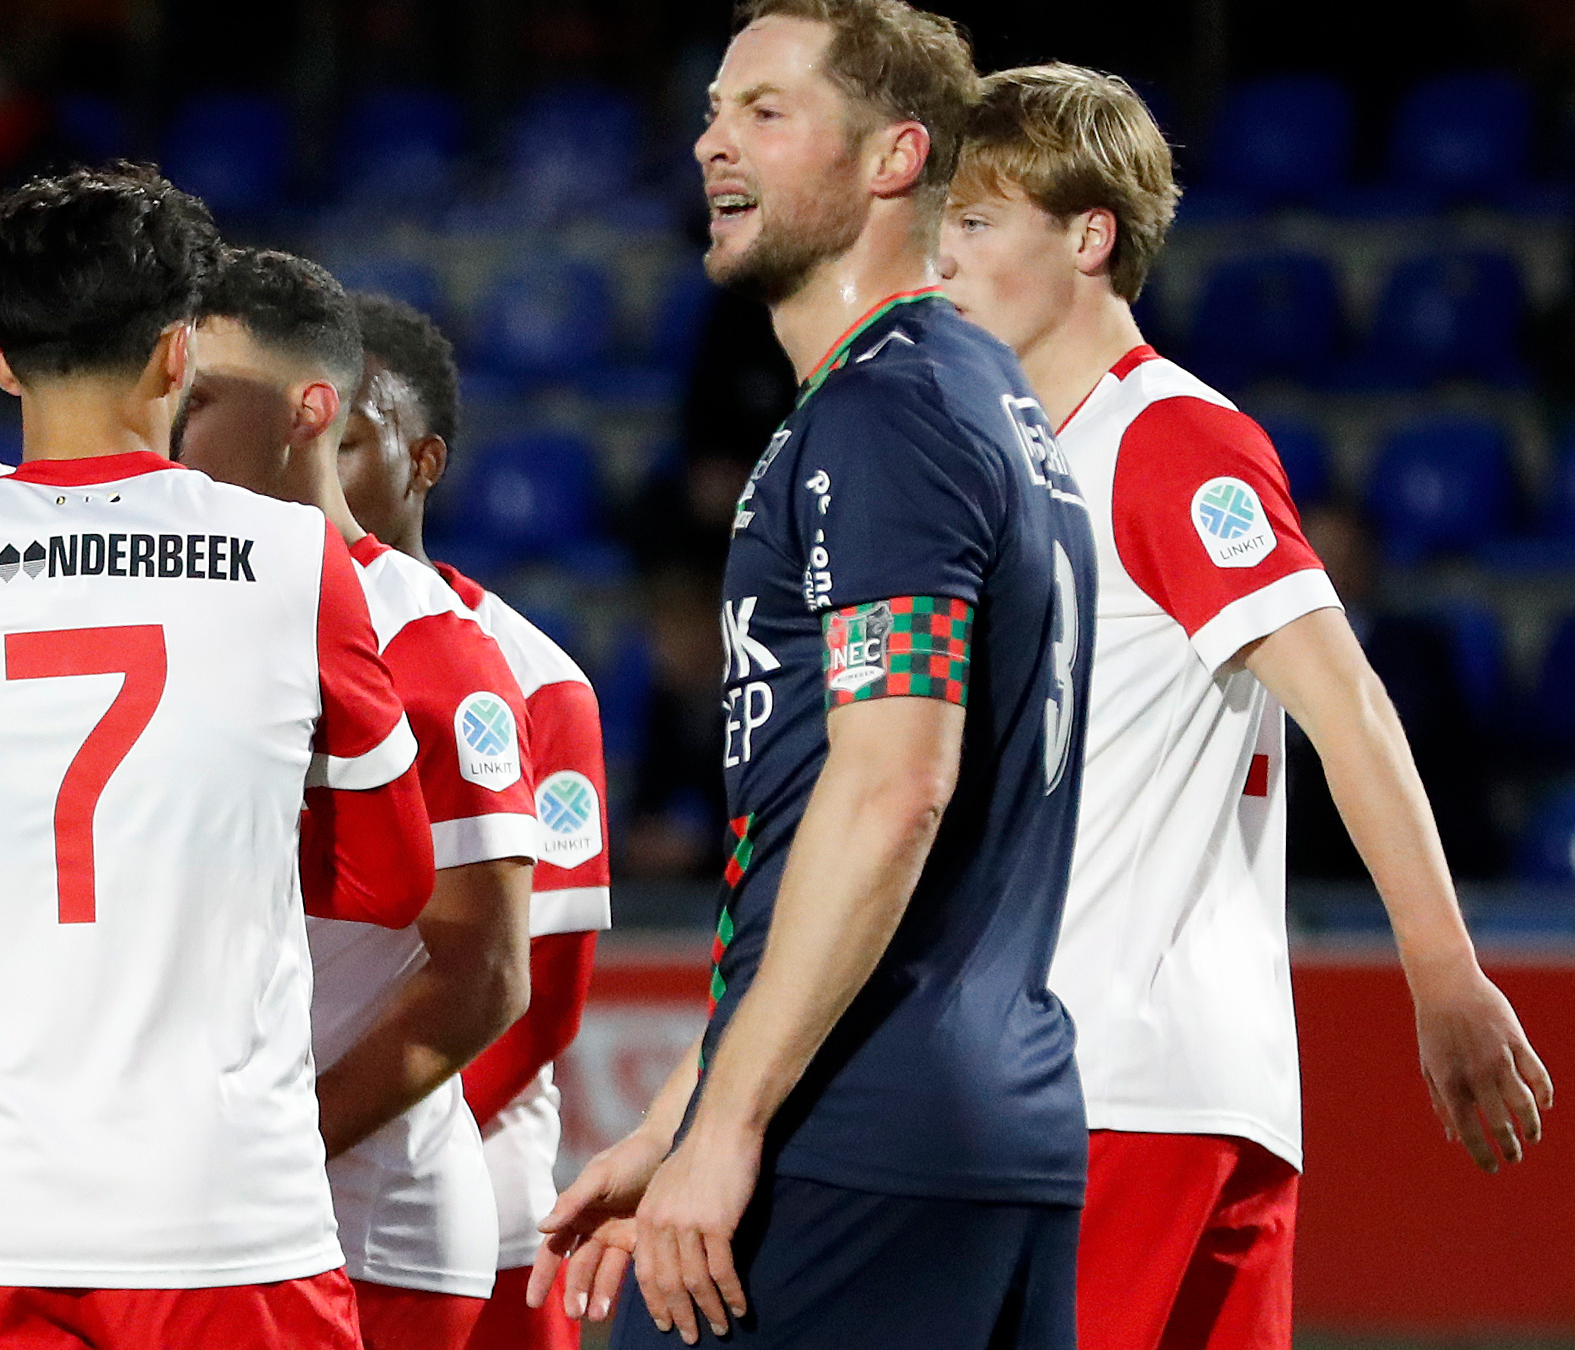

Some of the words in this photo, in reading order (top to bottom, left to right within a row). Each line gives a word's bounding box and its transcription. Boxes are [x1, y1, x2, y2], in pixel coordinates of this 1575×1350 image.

[1219, 535, 1265, 560] LINKIT
[833, 637, 881, 670] NEC
[4, 623, 168, 924] 7
[470, 762, 513, 775] LINKIT
[544, 838, 592, 852] LINKIT
